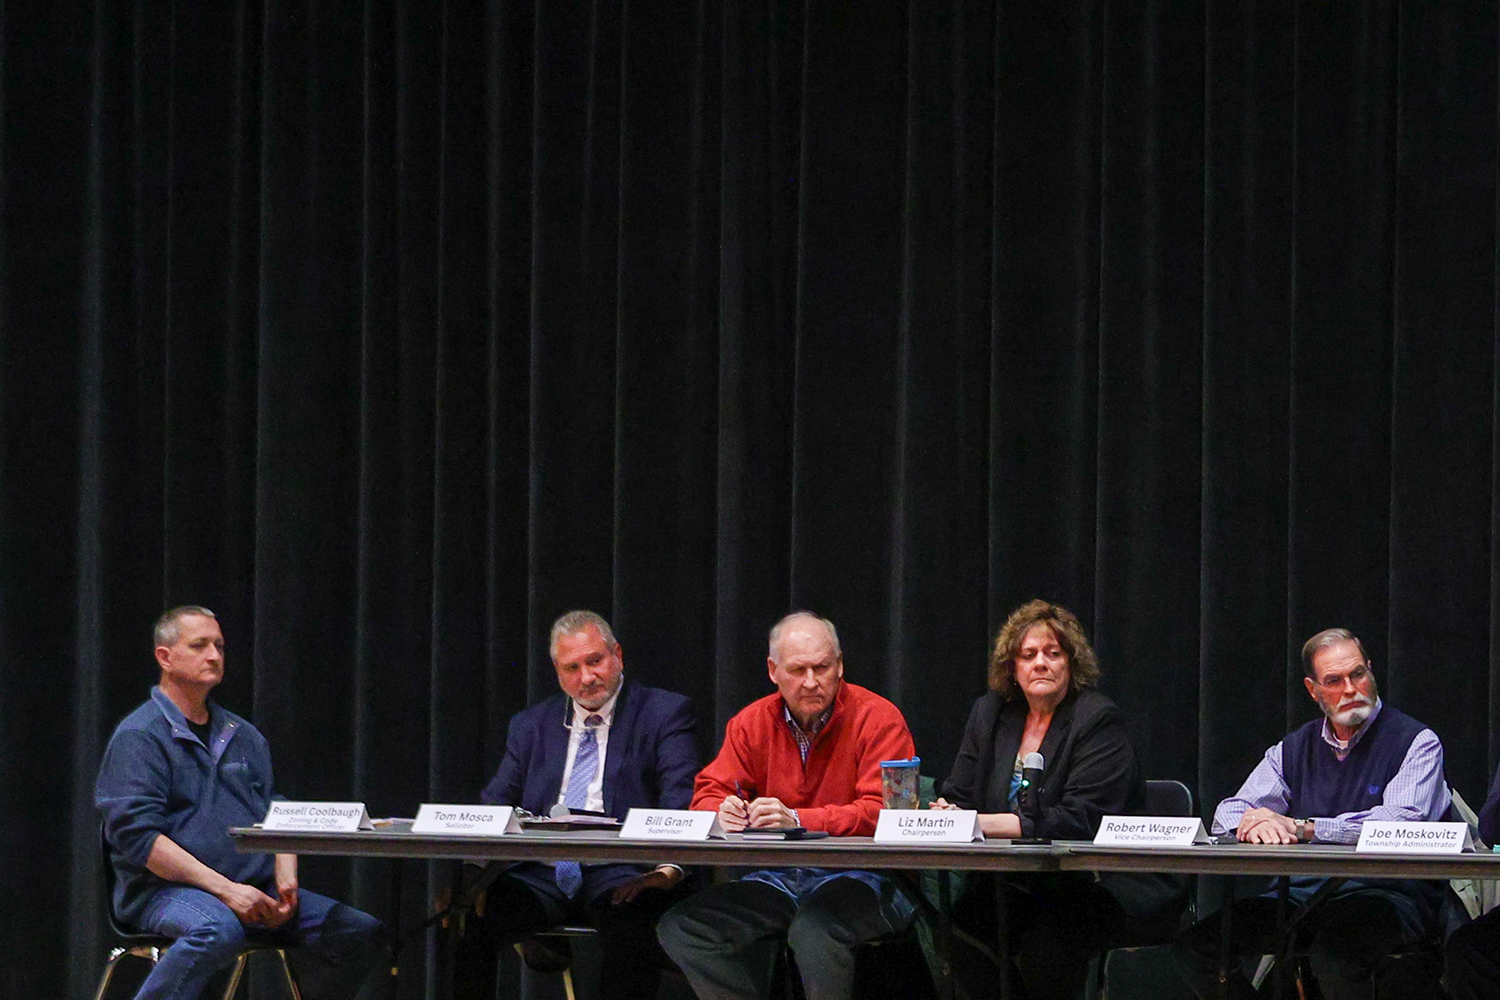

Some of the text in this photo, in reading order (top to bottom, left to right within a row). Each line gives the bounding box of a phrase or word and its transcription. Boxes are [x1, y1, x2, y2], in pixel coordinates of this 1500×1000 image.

[272, 806, 360, 818] Russell Coolbaugh
[434, 811, 494, 822] Tom Mosca
[645, 816, 694, 827] Bill Grant
[898, 817, 955, 828] Liz Martin
[647, 827, 683, 835] Supervisor
[902, 829, 947, 837] Chairperson
[1106, 822, 1192, 835] Robert Wagner
[1369, 828, 1457, 839] Joe Moskovitz
[1131, 834, 1176, 842] Chairperson
[1365, 840, 1457, 848] Township Administrator
